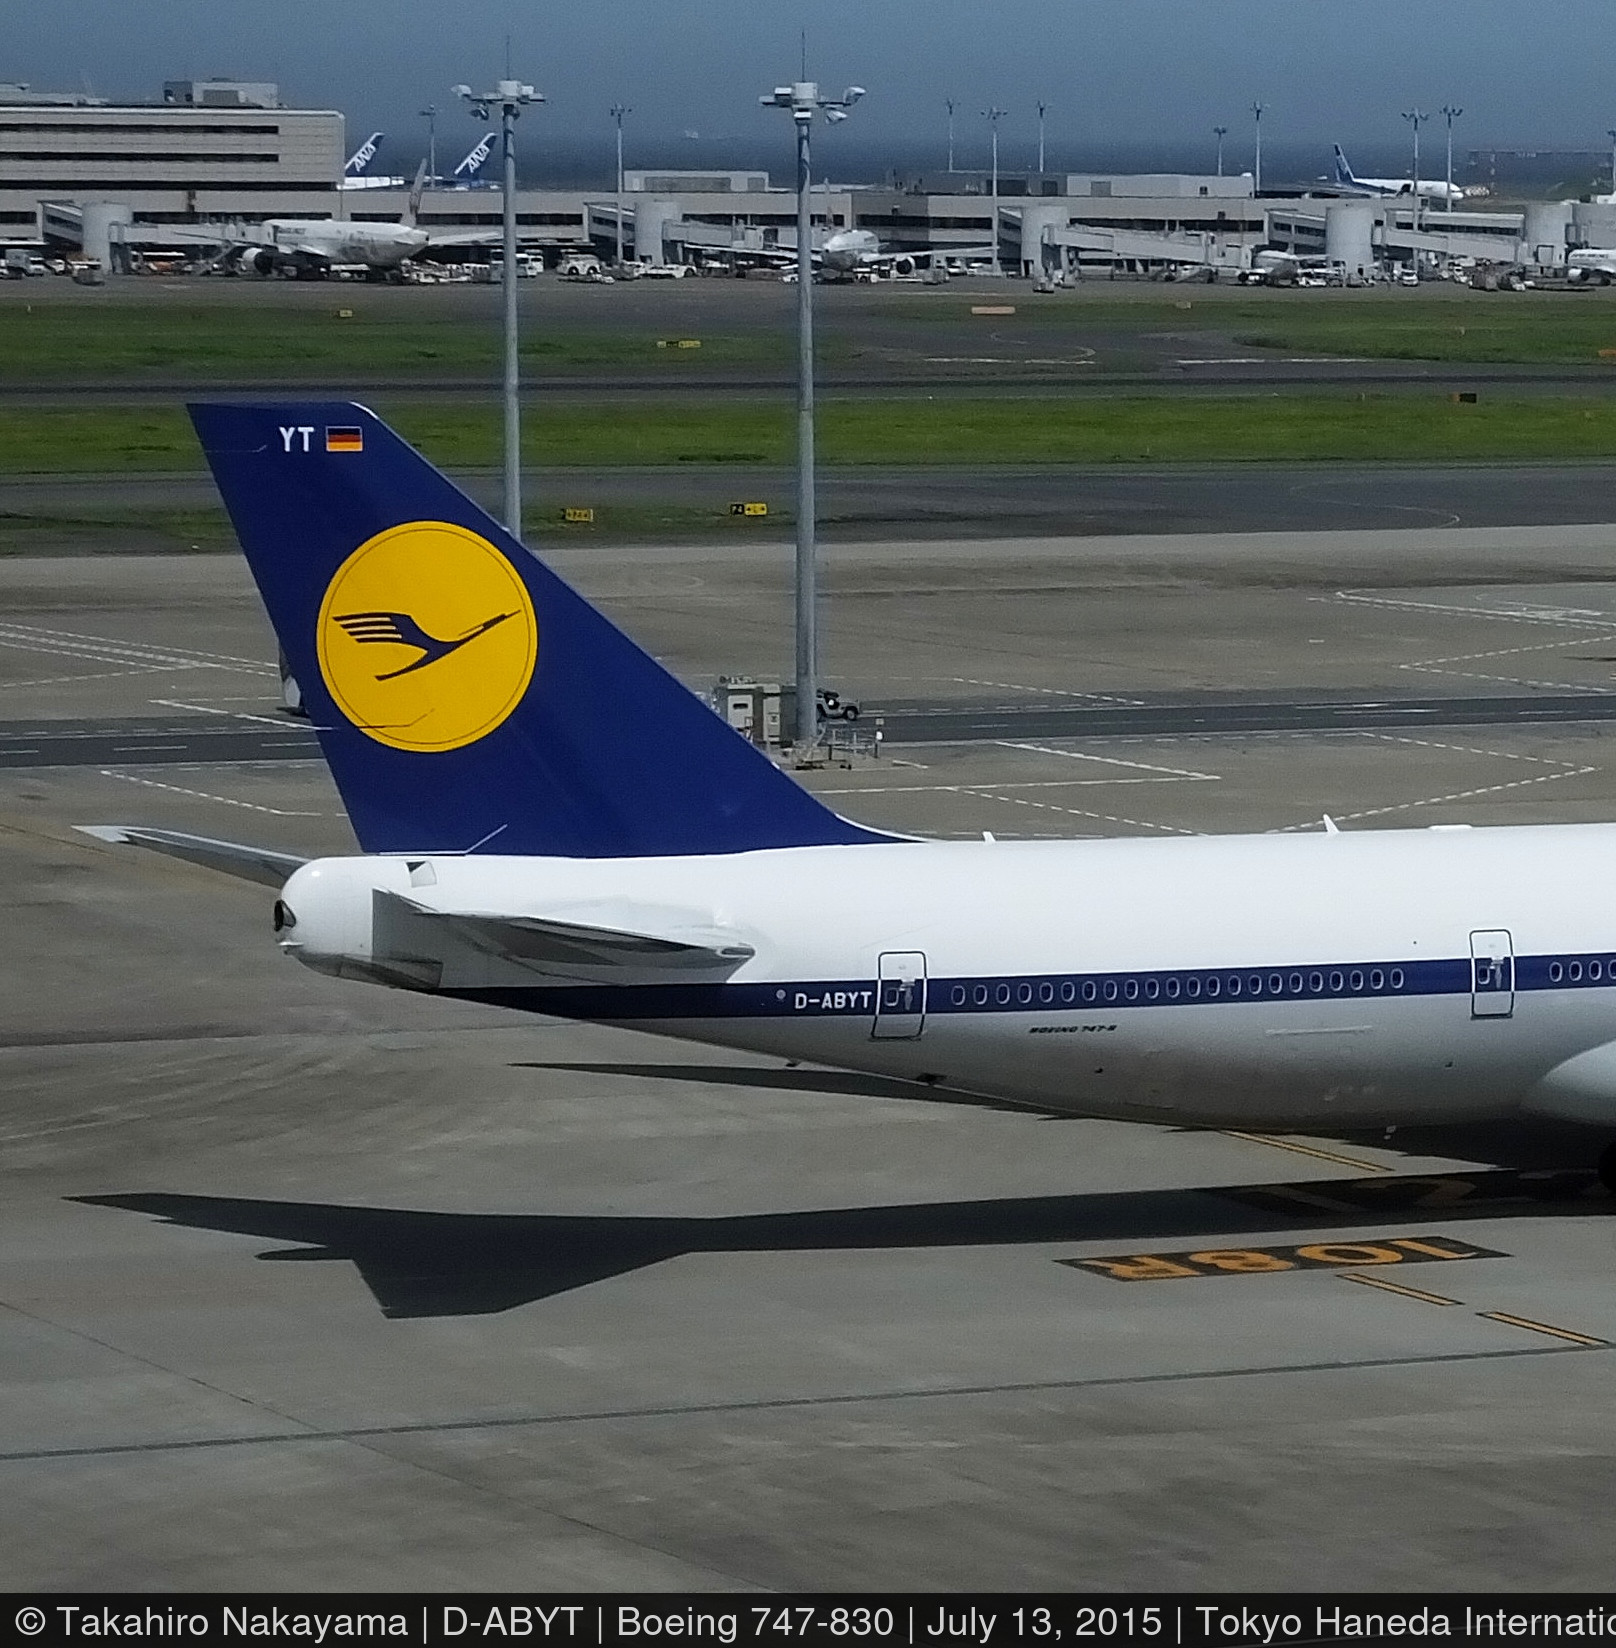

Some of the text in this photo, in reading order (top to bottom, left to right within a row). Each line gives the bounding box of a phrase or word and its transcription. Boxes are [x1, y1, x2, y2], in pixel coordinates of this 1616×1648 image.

[353, 141, 377, 173] ANA
[467, 143, 491, 174] ANA
[279, 426, 315, 452] YT
[794, 991, 873, 1010] D-ABYT
